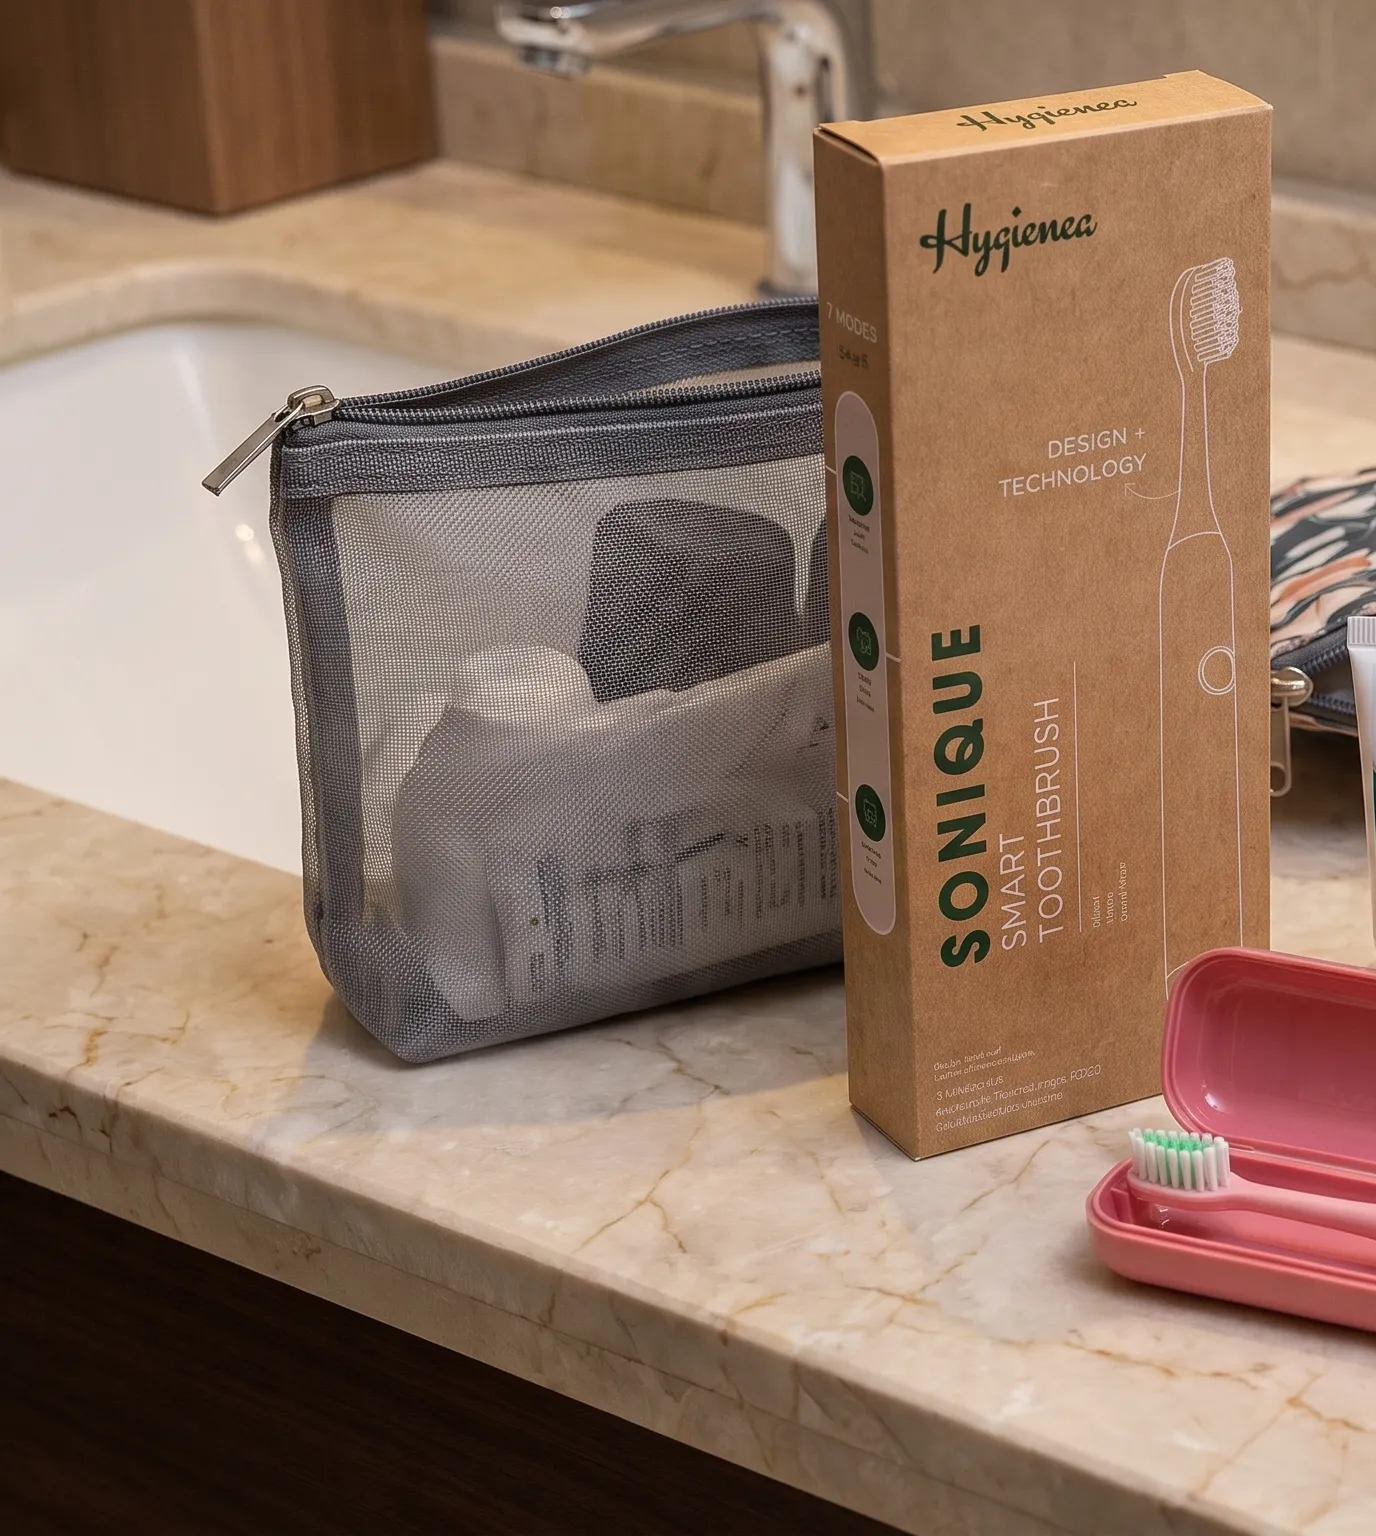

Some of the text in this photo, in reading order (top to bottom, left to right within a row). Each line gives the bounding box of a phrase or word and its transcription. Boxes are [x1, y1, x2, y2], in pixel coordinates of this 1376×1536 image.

[957, 97, 1138, 132] Hygienea
[919, 202, 1099, 277] Hygienea
[826, 301, 878, 344] 7 MODES
[1048, 428, 1127, 460] DESIGN
[999, 453, 1148, 498] TECHNOLOGY
[931, 623, 991, 968] SONIQUE
[1034, 698, 1064, 944] TOOTHBRUSH
[999, 832, 1028, 951] SMART
